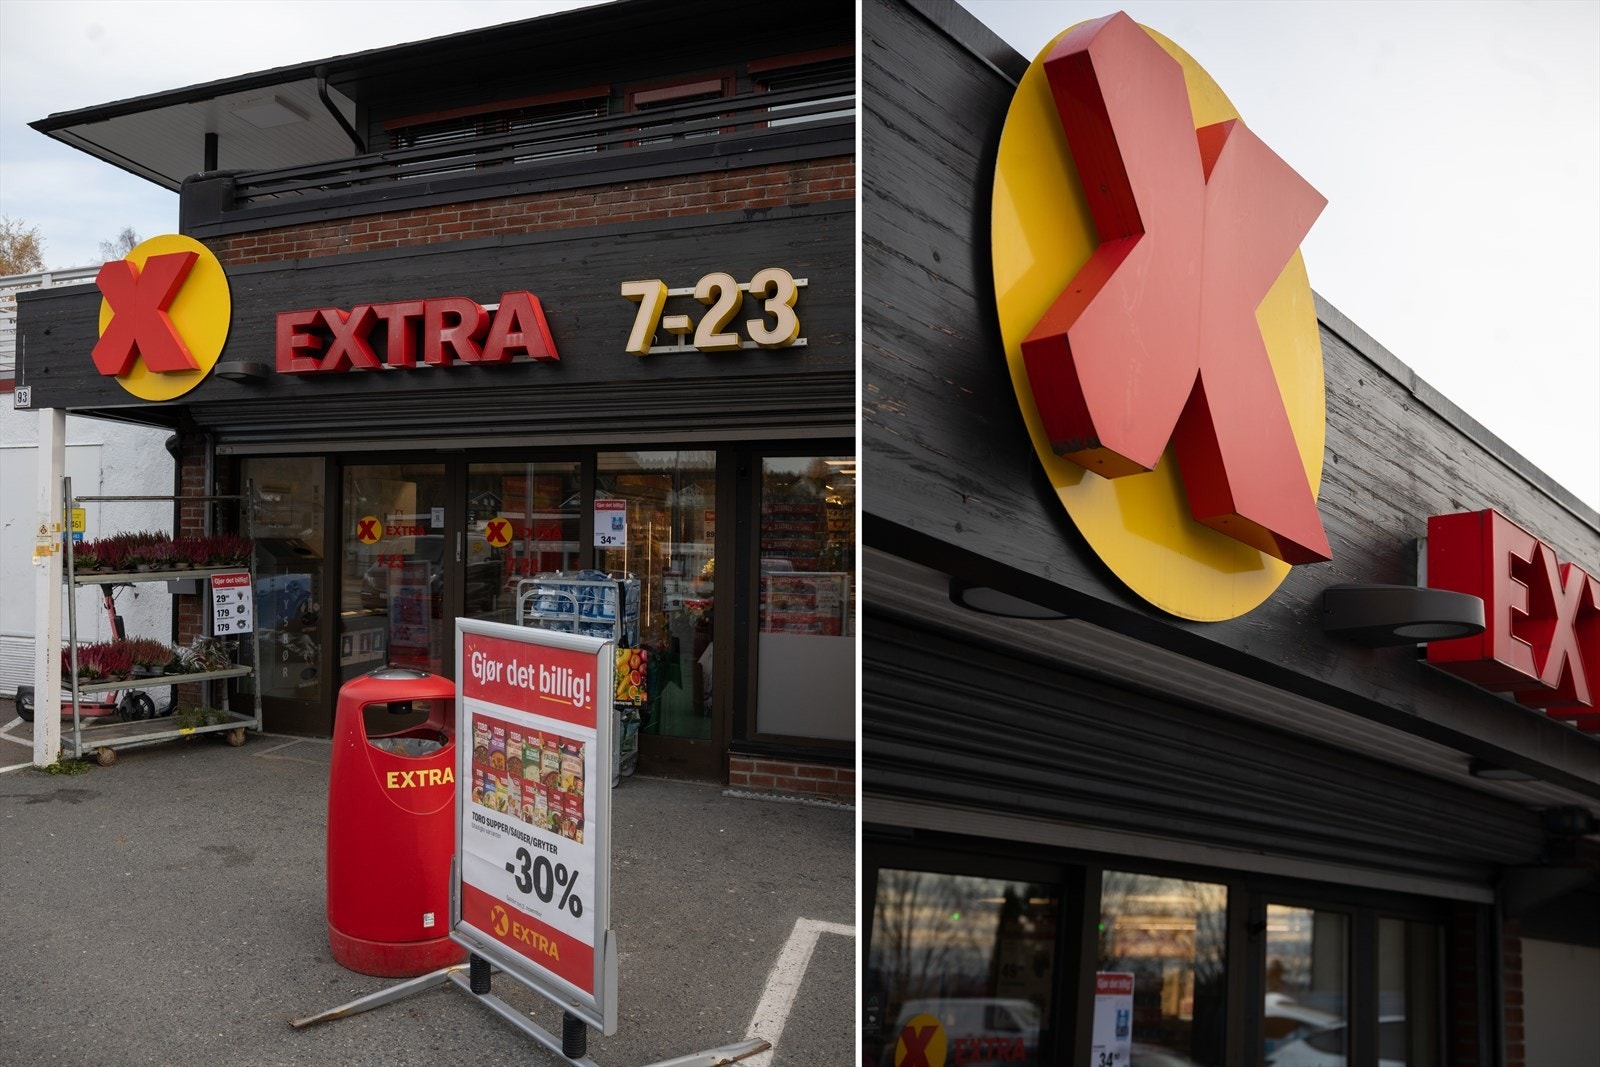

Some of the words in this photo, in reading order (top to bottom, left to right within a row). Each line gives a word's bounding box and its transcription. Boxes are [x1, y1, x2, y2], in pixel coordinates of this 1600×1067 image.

[621, 267, 800, 357] 7-23
[275, 290, 561, 376] EXTRA
[17, 391, 28, 404] 93
[385, 525, 427, 536] EXTRA
[600, 535, 612, 544] 34
[377, 554, 405, 569] 7-23
[214, 578, 225, 586] Gjør
[216, 594, 226, 603] 29
[217, 609, 230, 618] 179
[217, 623, 230, 632] 179
[471, 651, 503, 686] Gjør
[506, 659, 535, 691] det
[539, 663, 591, 707] billig!
[477, 721, 488, 732] TORO
[494, 726, 504, 737] TORO
[510, 731, 521, 741] TORO
[386, 767, 455, 789] EXTRA
[472, 811, 486, 825] TORO
[486, 817, 558, 855] SUPPER/SAUSER/GRYTER
[505, 847, 583, 918] -30%
[512, 920, 560, 961] EXTRA
[955, 1037, 1026, 1065] EXTRA
